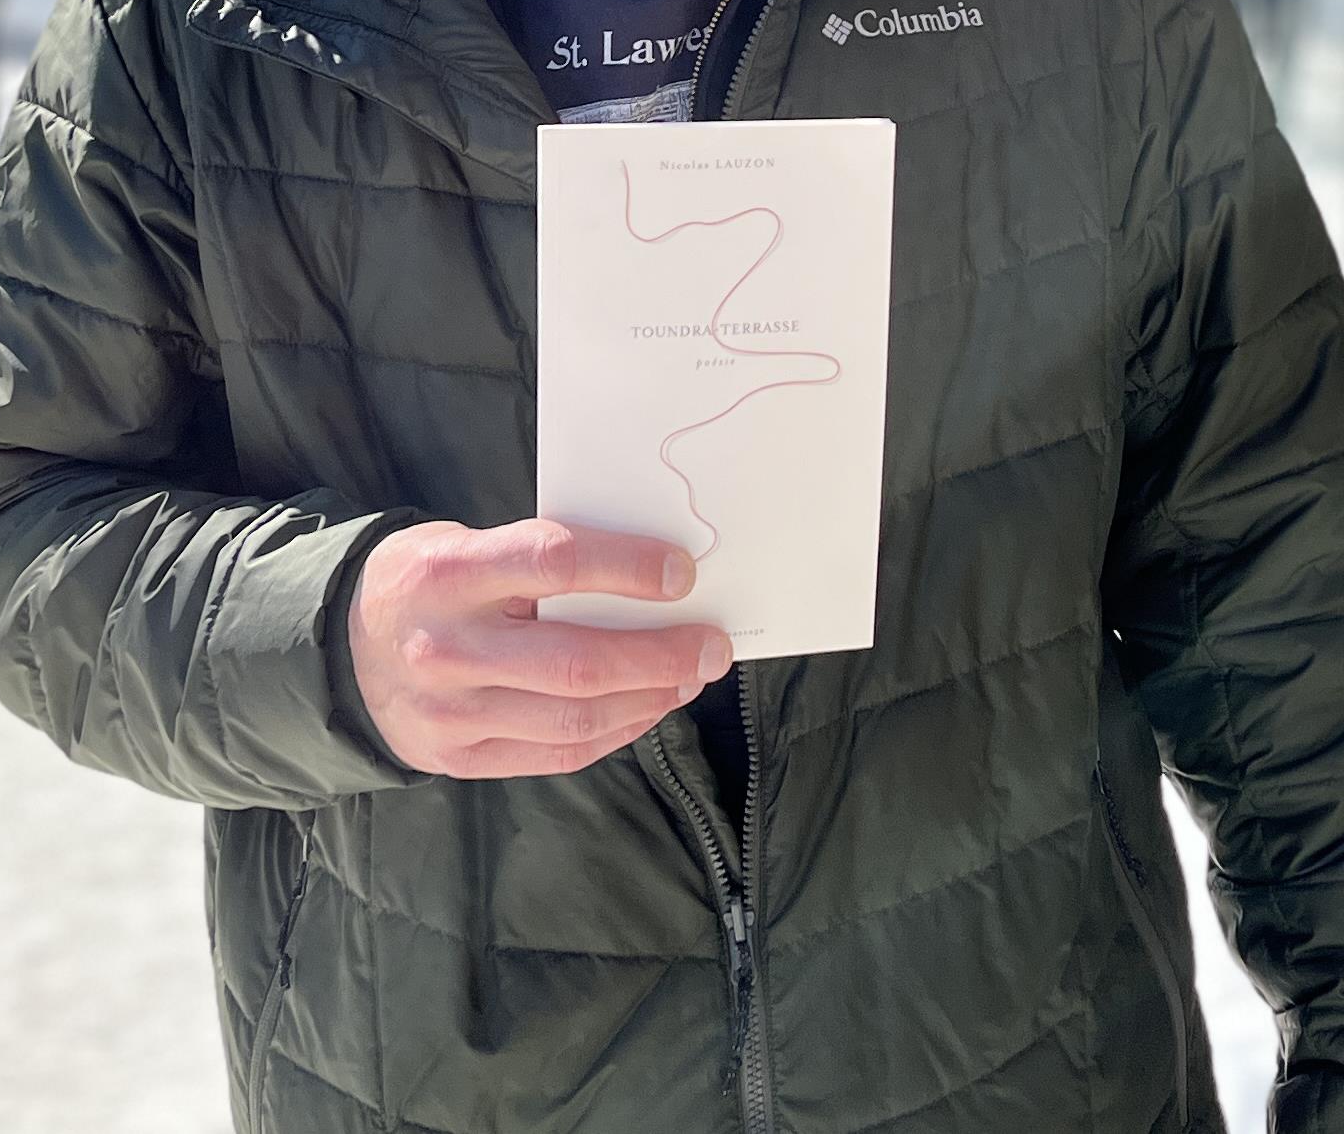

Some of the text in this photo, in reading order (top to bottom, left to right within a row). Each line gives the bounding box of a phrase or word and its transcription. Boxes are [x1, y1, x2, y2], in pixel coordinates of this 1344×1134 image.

[854, 1, 984, 38] Columbia
[545, 35, 588, 70] St.
[715, 156, 776, 170] LAUZON
